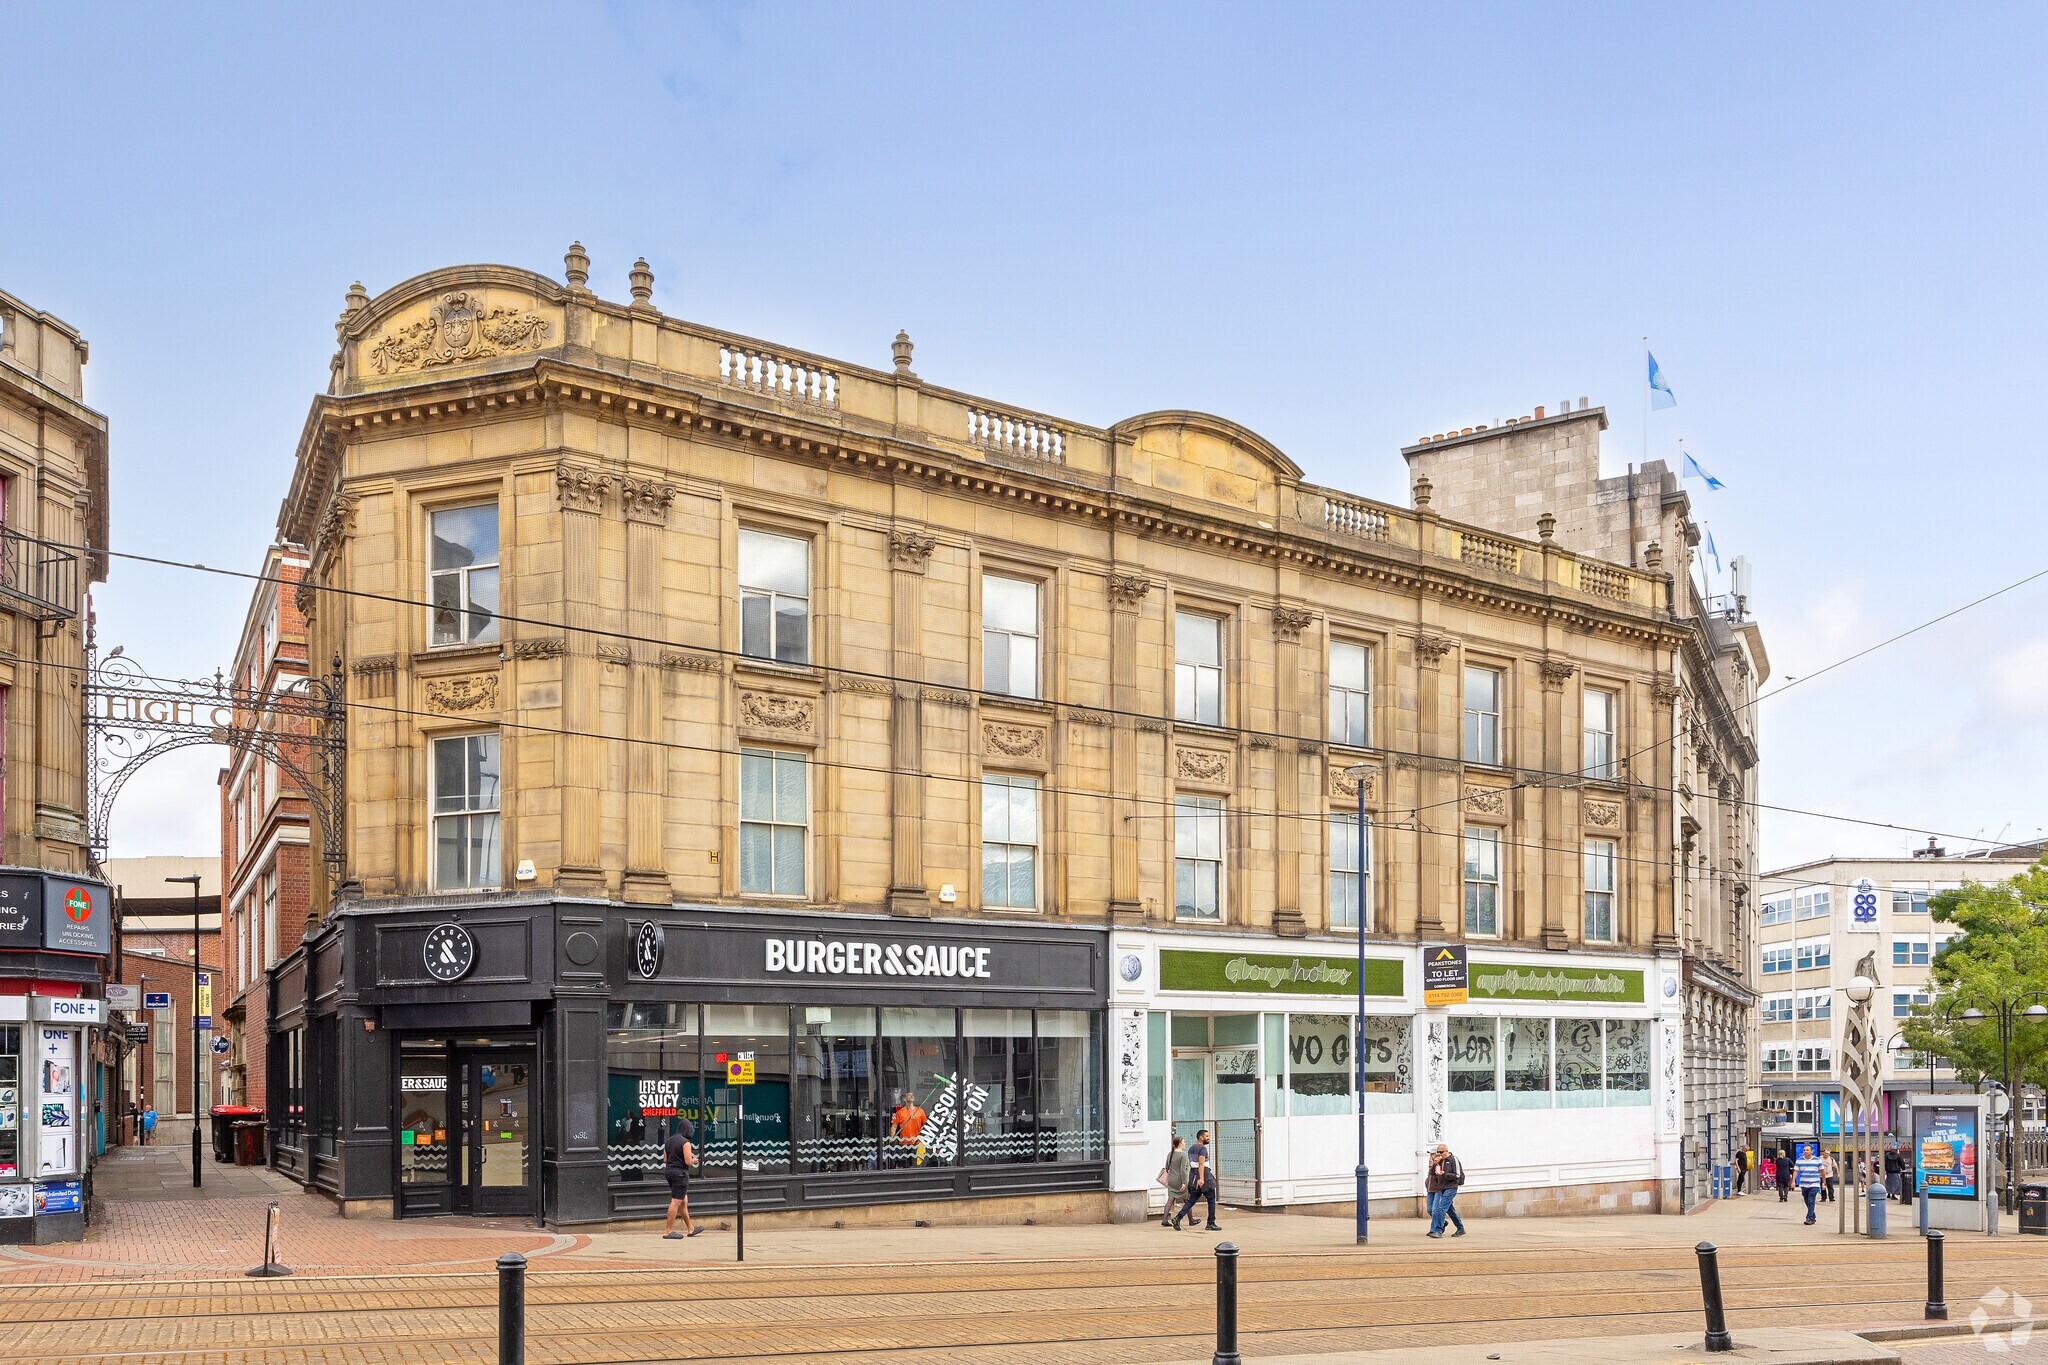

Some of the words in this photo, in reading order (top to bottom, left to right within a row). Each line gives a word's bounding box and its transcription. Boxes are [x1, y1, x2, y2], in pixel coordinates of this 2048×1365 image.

[106, 696, 195, 725] HIGH
[210, 708, 325, 737] COURT
[69, 900, 87, 909] FONE
[0, 923, 25, 931] RIES
[66, 923, 90, 931] REPAIRS
[62, 931, 94, 939] UNLOCKING
[428, 929, 467, 950] BURGER
[58, 938, 97, 947] ACCESSORIES
[765, 938, 991, 978] BURGER&SAUCE
[431, 959, 466, 976] SAUCE
[1225, 956, 1286, 989] Glory
[1292, 959, 1352, 986] holes
[1431, 970, 1443, 978] TO
[1443, 969, 1459, 977] LET
[1477, 974, 1485, 989] a
[1489, 969, 1518, 996] golf
[1522, 970, 1551, 991] club
[1583, 973, 1625, 993] adults
[54, 1002, 85, 1014] FONE
[1289, 1034, 1323, 1065] NO
[1331, 1034, 1392, 1065] GTS
[657, 1080, 681, 1094] GET
[638, 1094, 680, 1108] SAUCY
[967, 1085, 989, 1111] ON
[642, 1108, 677, 1116] SHEFFIELD
[1923, 1135, 1942, 1143] YOUR
[1942, 1133, 1967, 1143] LUNCH
[1928, 1175, 1950, 1185] £3.95
